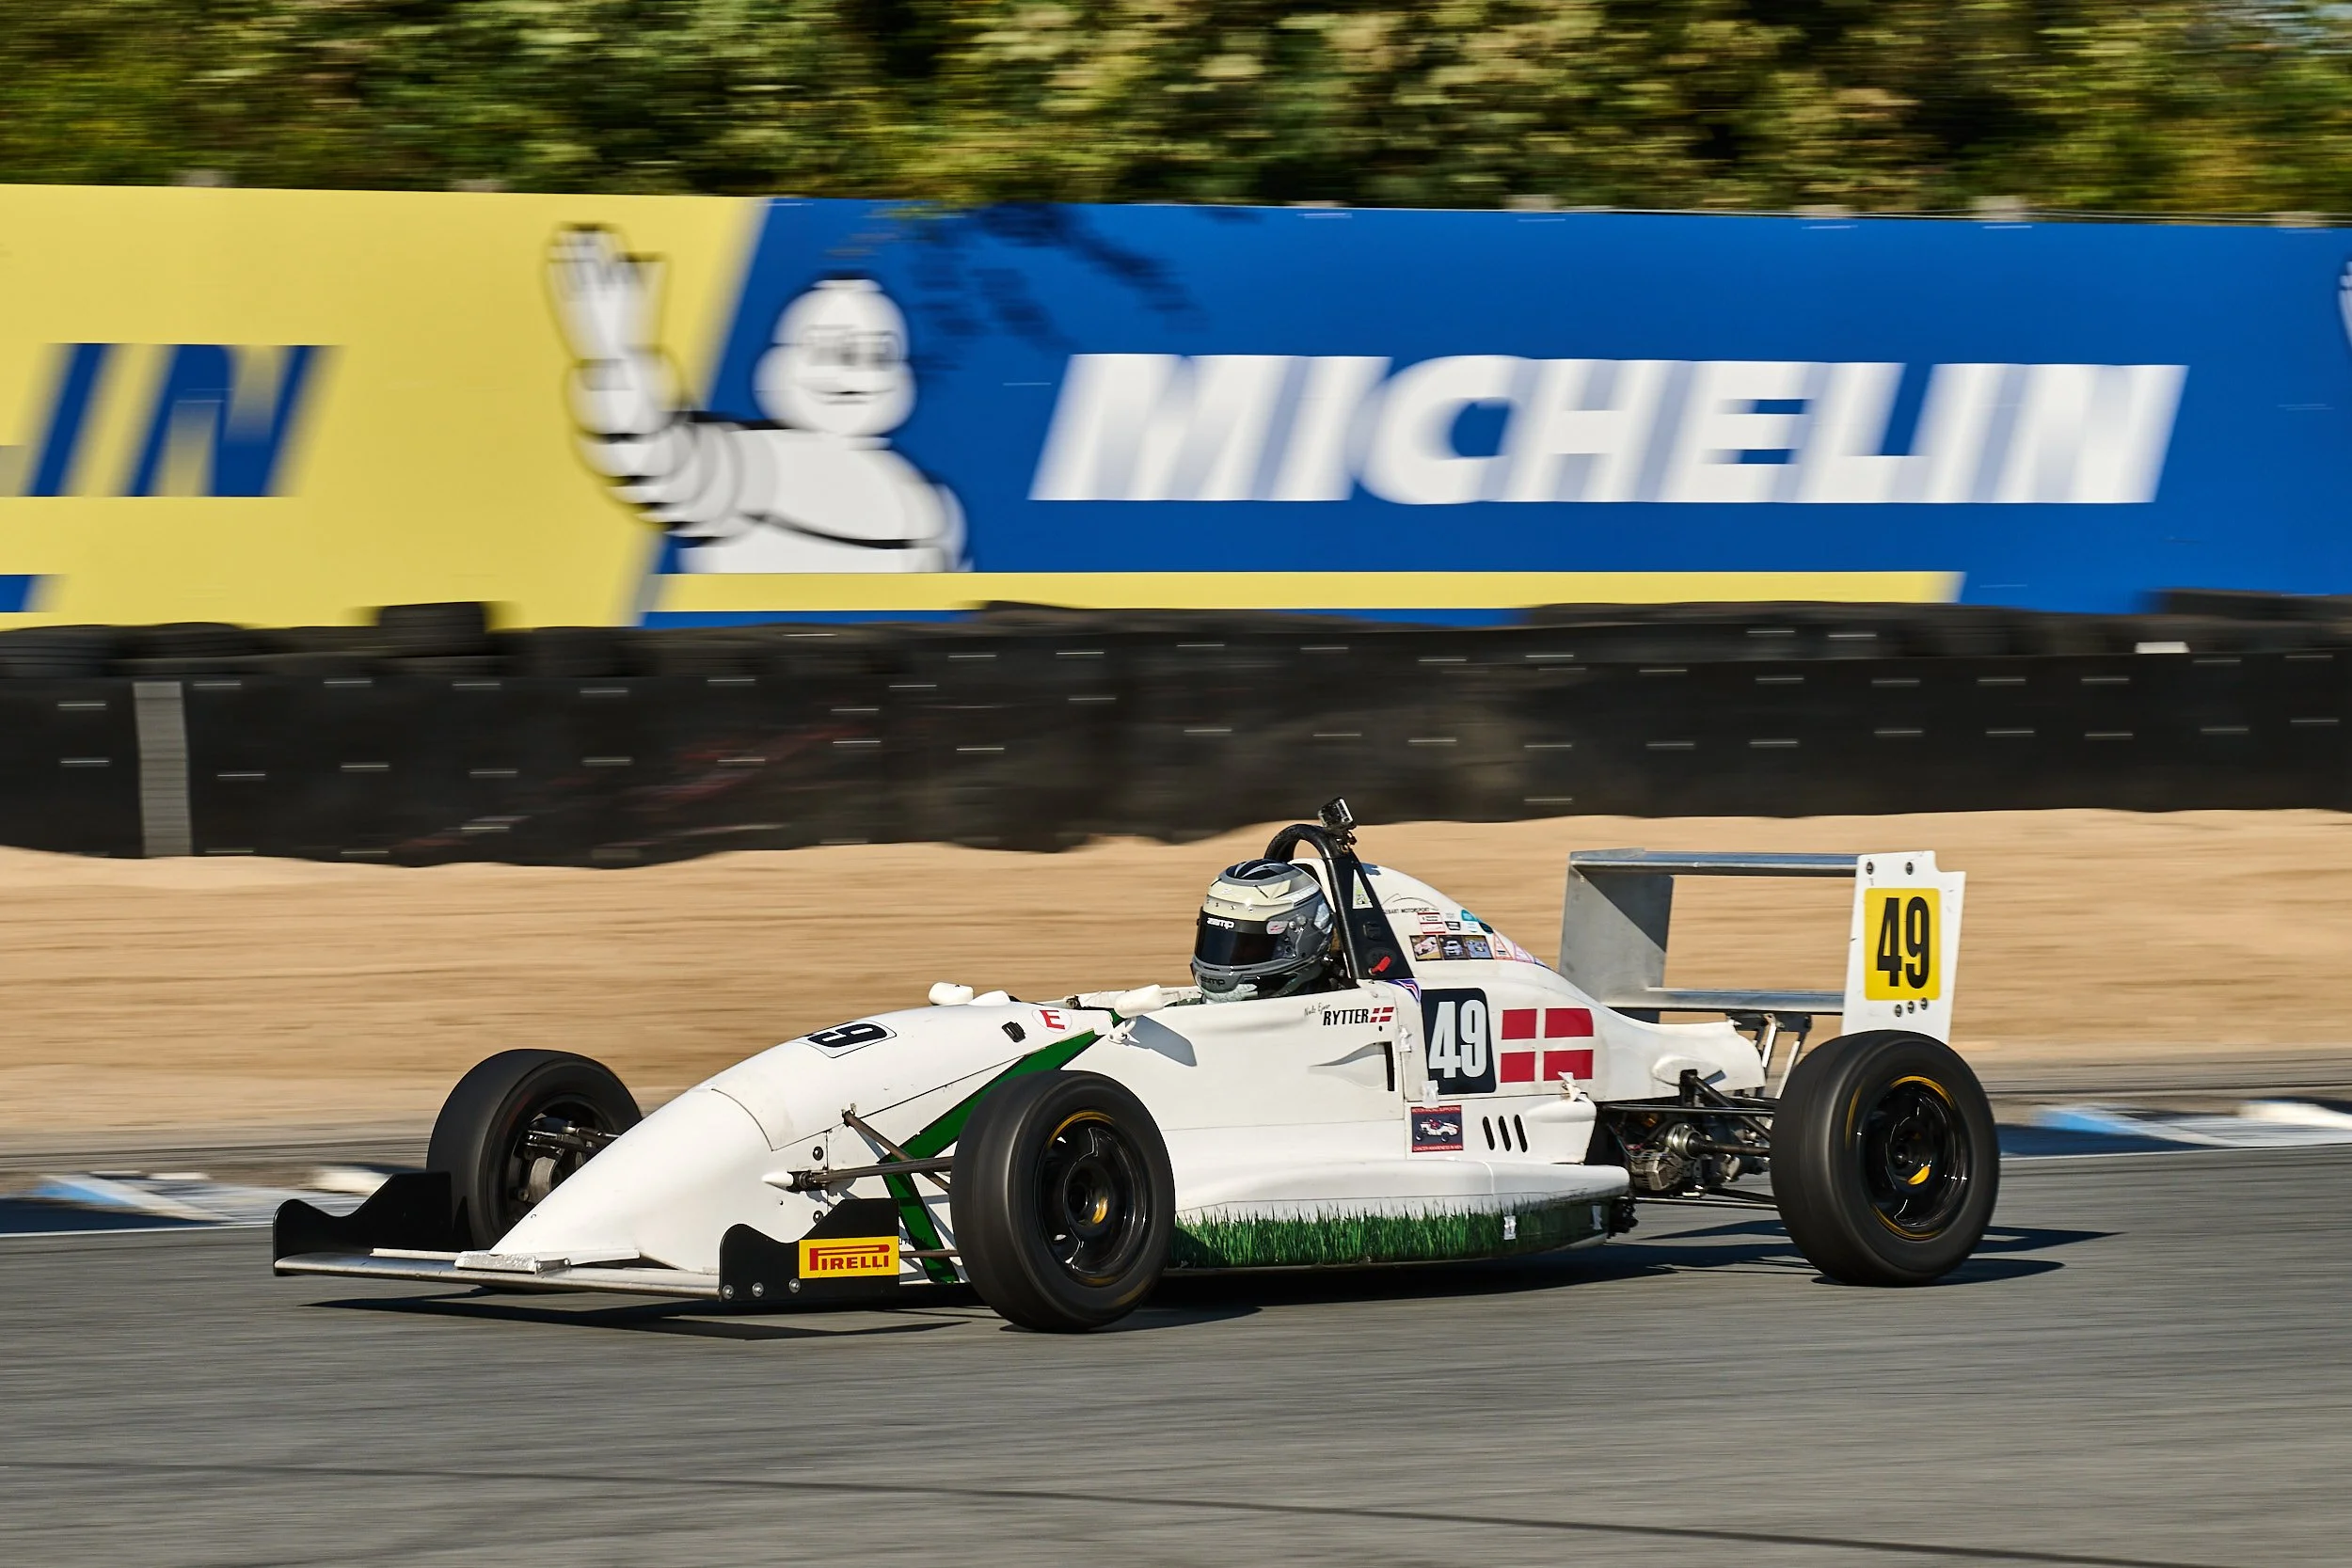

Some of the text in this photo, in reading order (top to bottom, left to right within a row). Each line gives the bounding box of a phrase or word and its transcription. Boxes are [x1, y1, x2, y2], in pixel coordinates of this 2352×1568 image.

[0, 342, 342, 498] IN
[1027, 353, 2190, 505] MICHELIN
[1876, 895, 1931, 990] 49
[1039, 1009, 1066, 1030] E
[1322, 1008, 1369, 1026] RYTTER
[1428, 999, 1487, 1079] 49
[809, 1243, 891, 1271] PIRELLI
